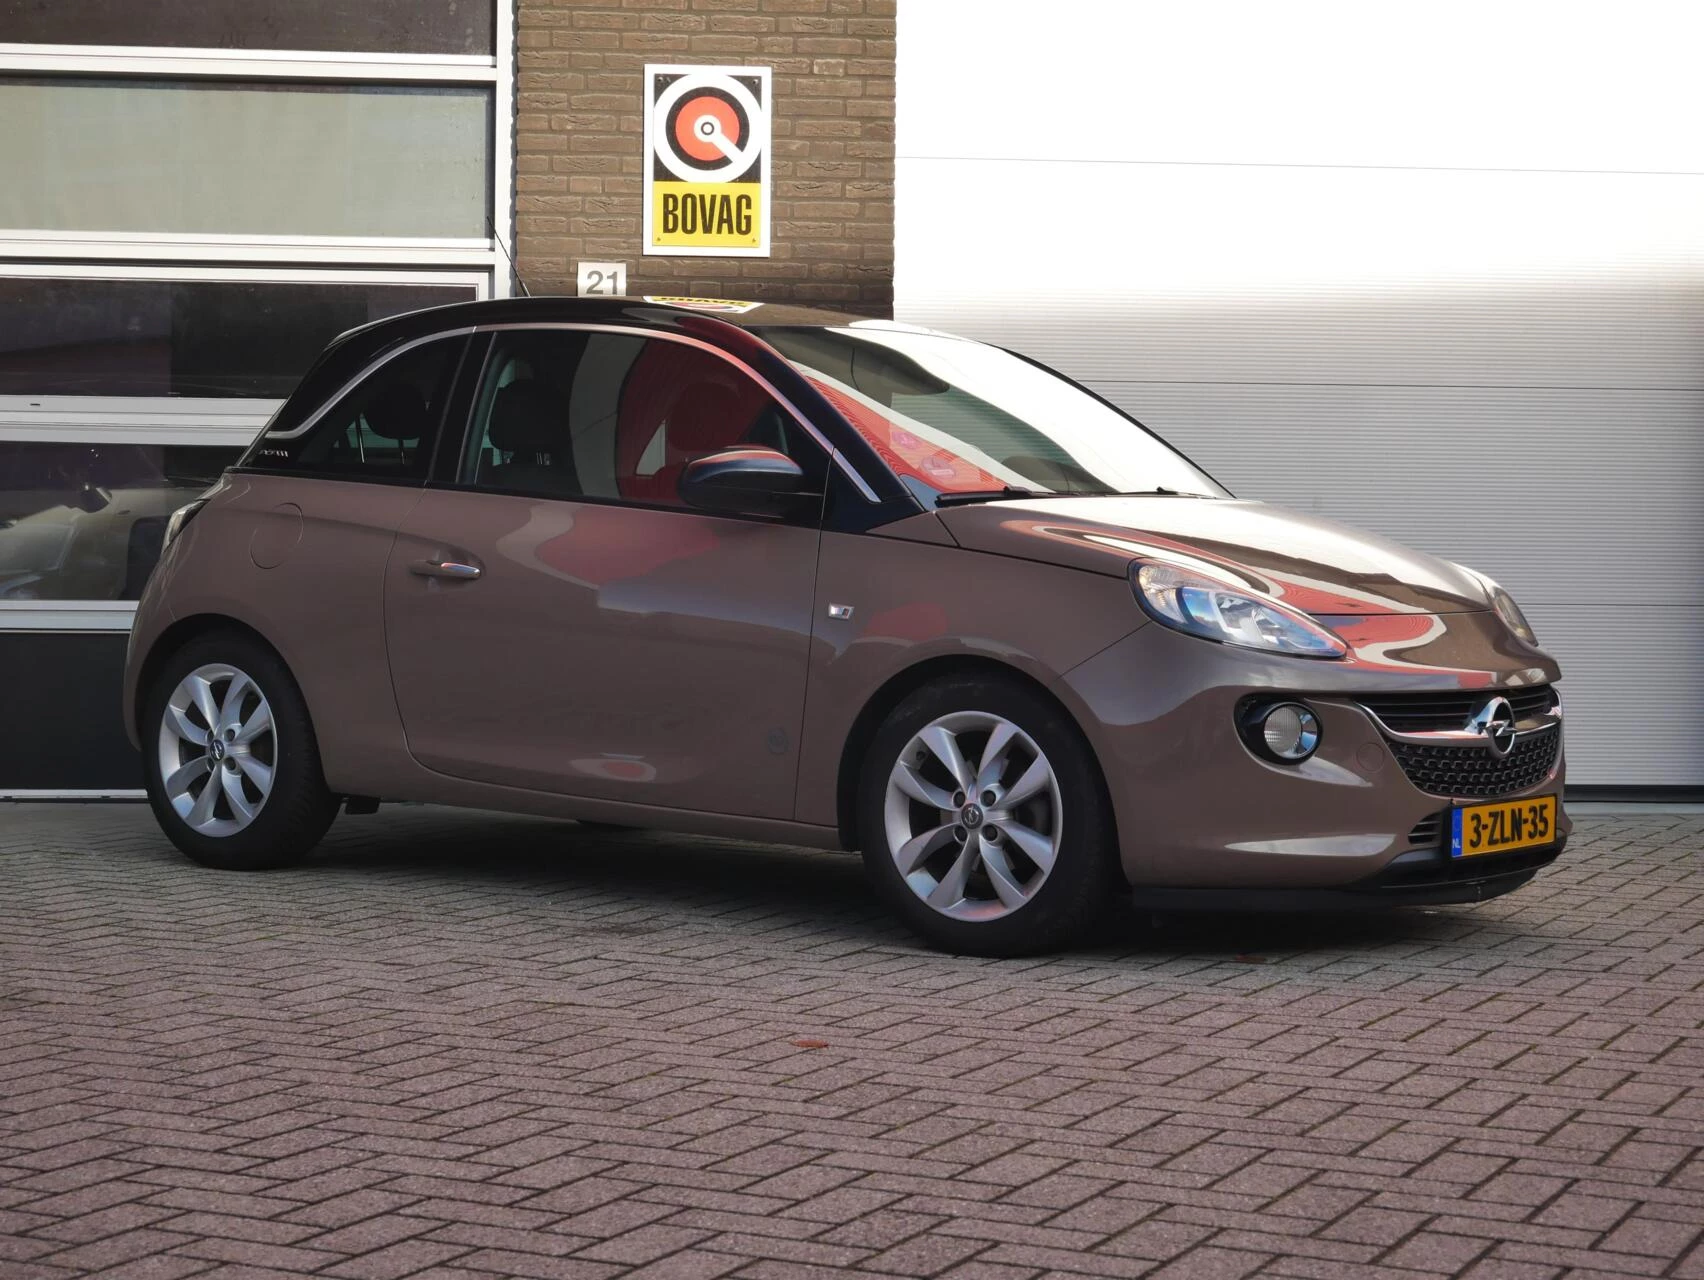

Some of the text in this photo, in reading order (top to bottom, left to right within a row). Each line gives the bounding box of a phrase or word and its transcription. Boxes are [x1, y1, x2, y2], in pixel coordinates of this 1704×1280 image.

[662, 192, 752, 236] BOVAG
[586, 270, 618, 295] 21
[1469, 803, 1549, 849] 3-ZLN-35
[1452, 838, 1461, 849] NL
